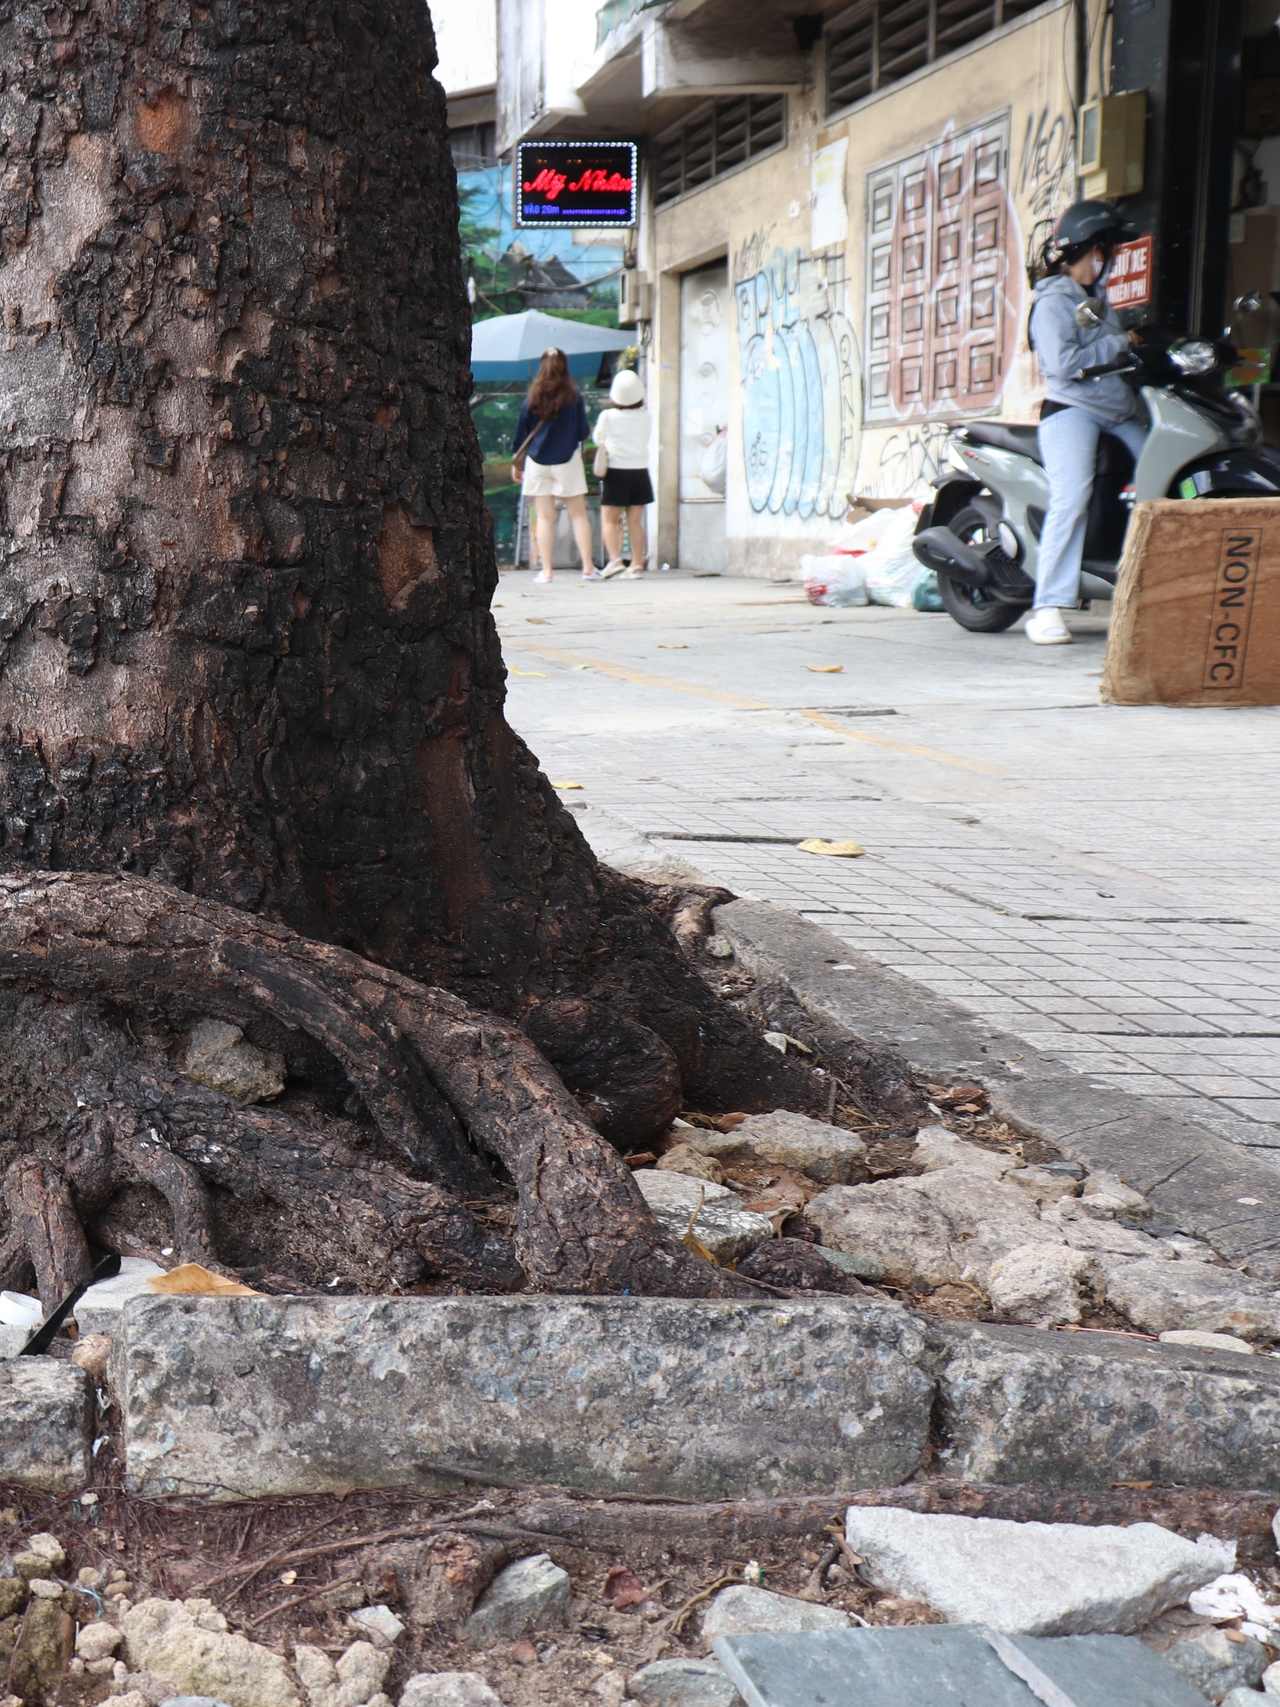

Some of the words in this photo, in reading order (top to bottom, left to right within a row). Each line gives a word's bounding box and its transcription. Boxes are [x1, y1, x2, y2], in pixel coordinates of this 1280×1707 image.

[1131, 247, 1148, 274] XE
[1132, 273, 1147, 299] PHÍ
[1210, 536, 1254, 682] NON-CFC
